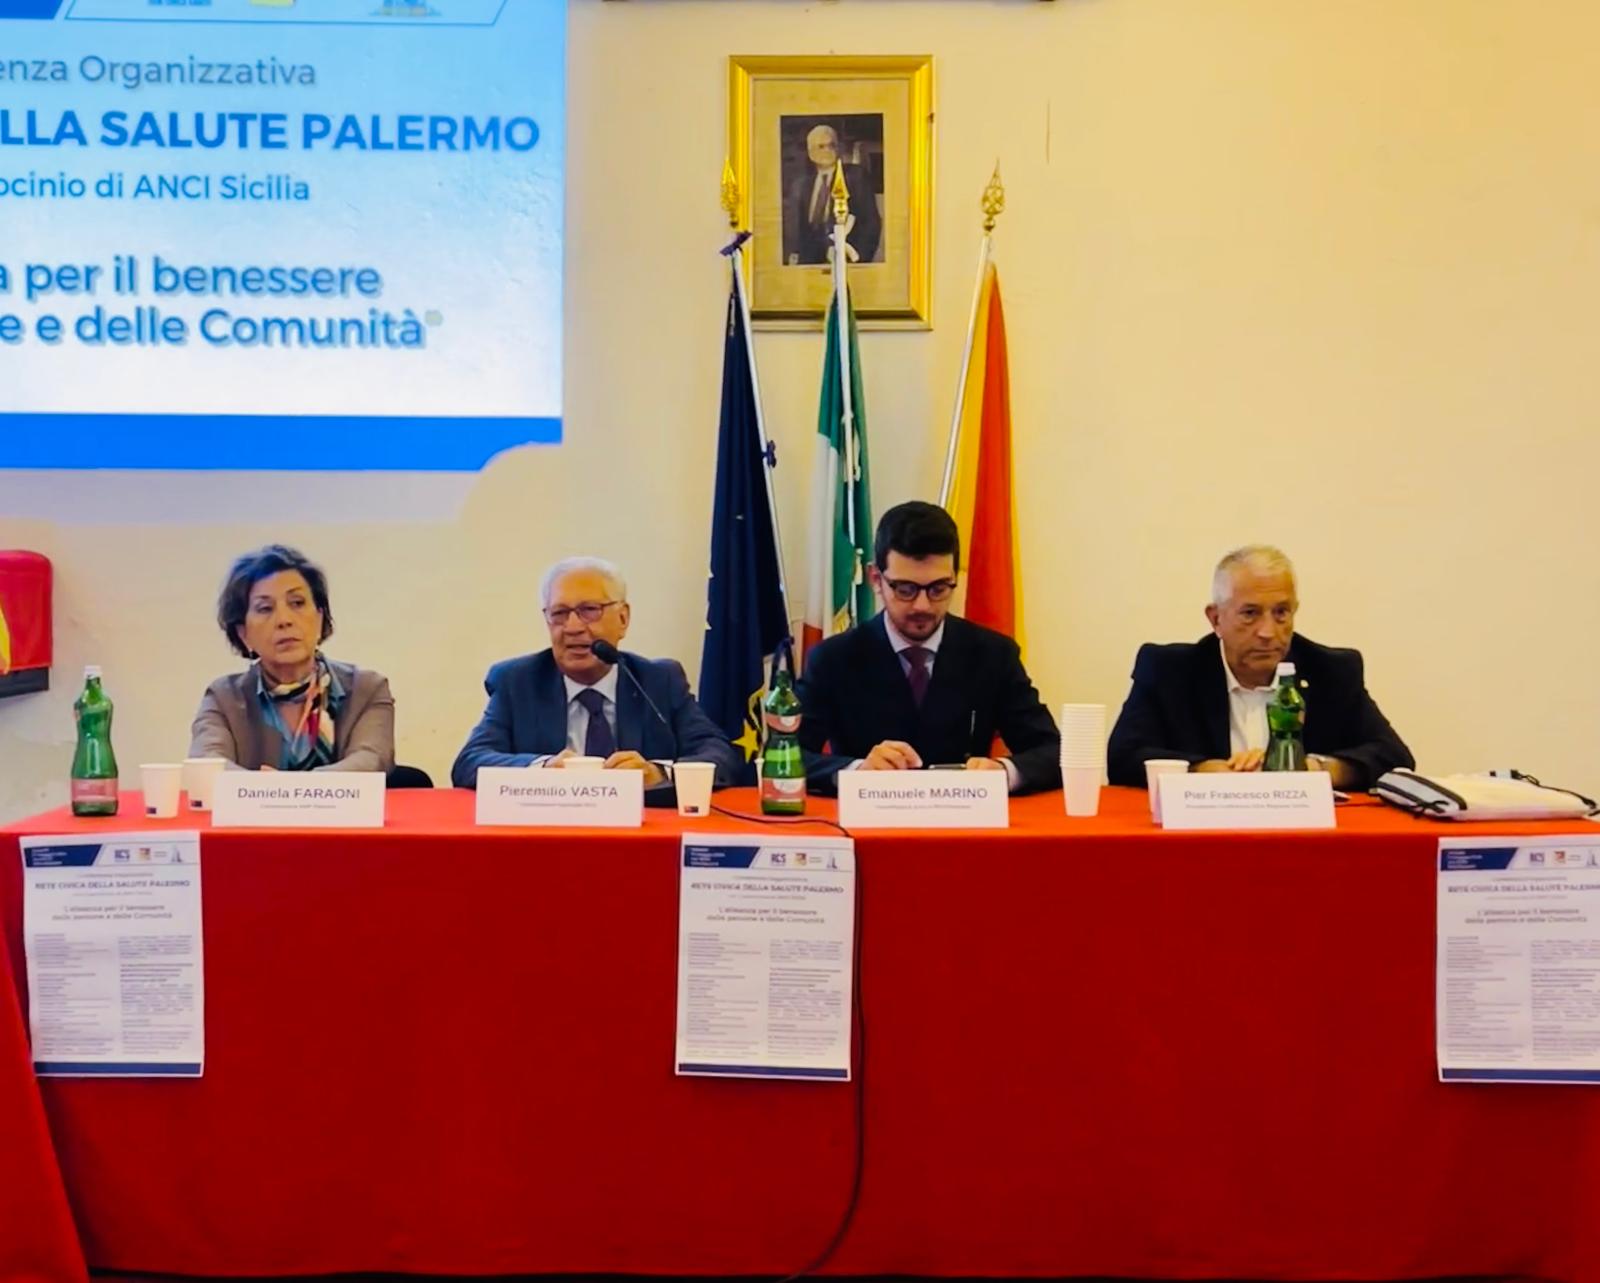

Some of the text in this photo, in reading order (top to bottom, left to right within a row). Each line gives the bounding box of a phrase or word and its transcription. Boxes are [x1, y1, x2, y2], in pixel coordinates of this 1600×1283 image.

[79, 55, 316, 89] Organizzativa
[0, 109, 540, 151] LLA SALUTE PALERMO
[95, 172, 124, 198] di
[133, 175, 210, 199] ANCI
[219, 172, 310, 200] Sicilia
[26, 264, 101, 301] per
[114, 254, 136, 293] il
[152, 254, 381, 295] benessere
[36, 315, 62, 342] e
[75, 304, 187, 344] delle
[237, 787, 360, 799] Daniela FARAONI
[499, 784, 618, 797] Pieremilio VASTA
[858, 787, 988, 799] Emanuele MARINO
[1184, 790, 1308, 800] Pier Francesco RIZZA
